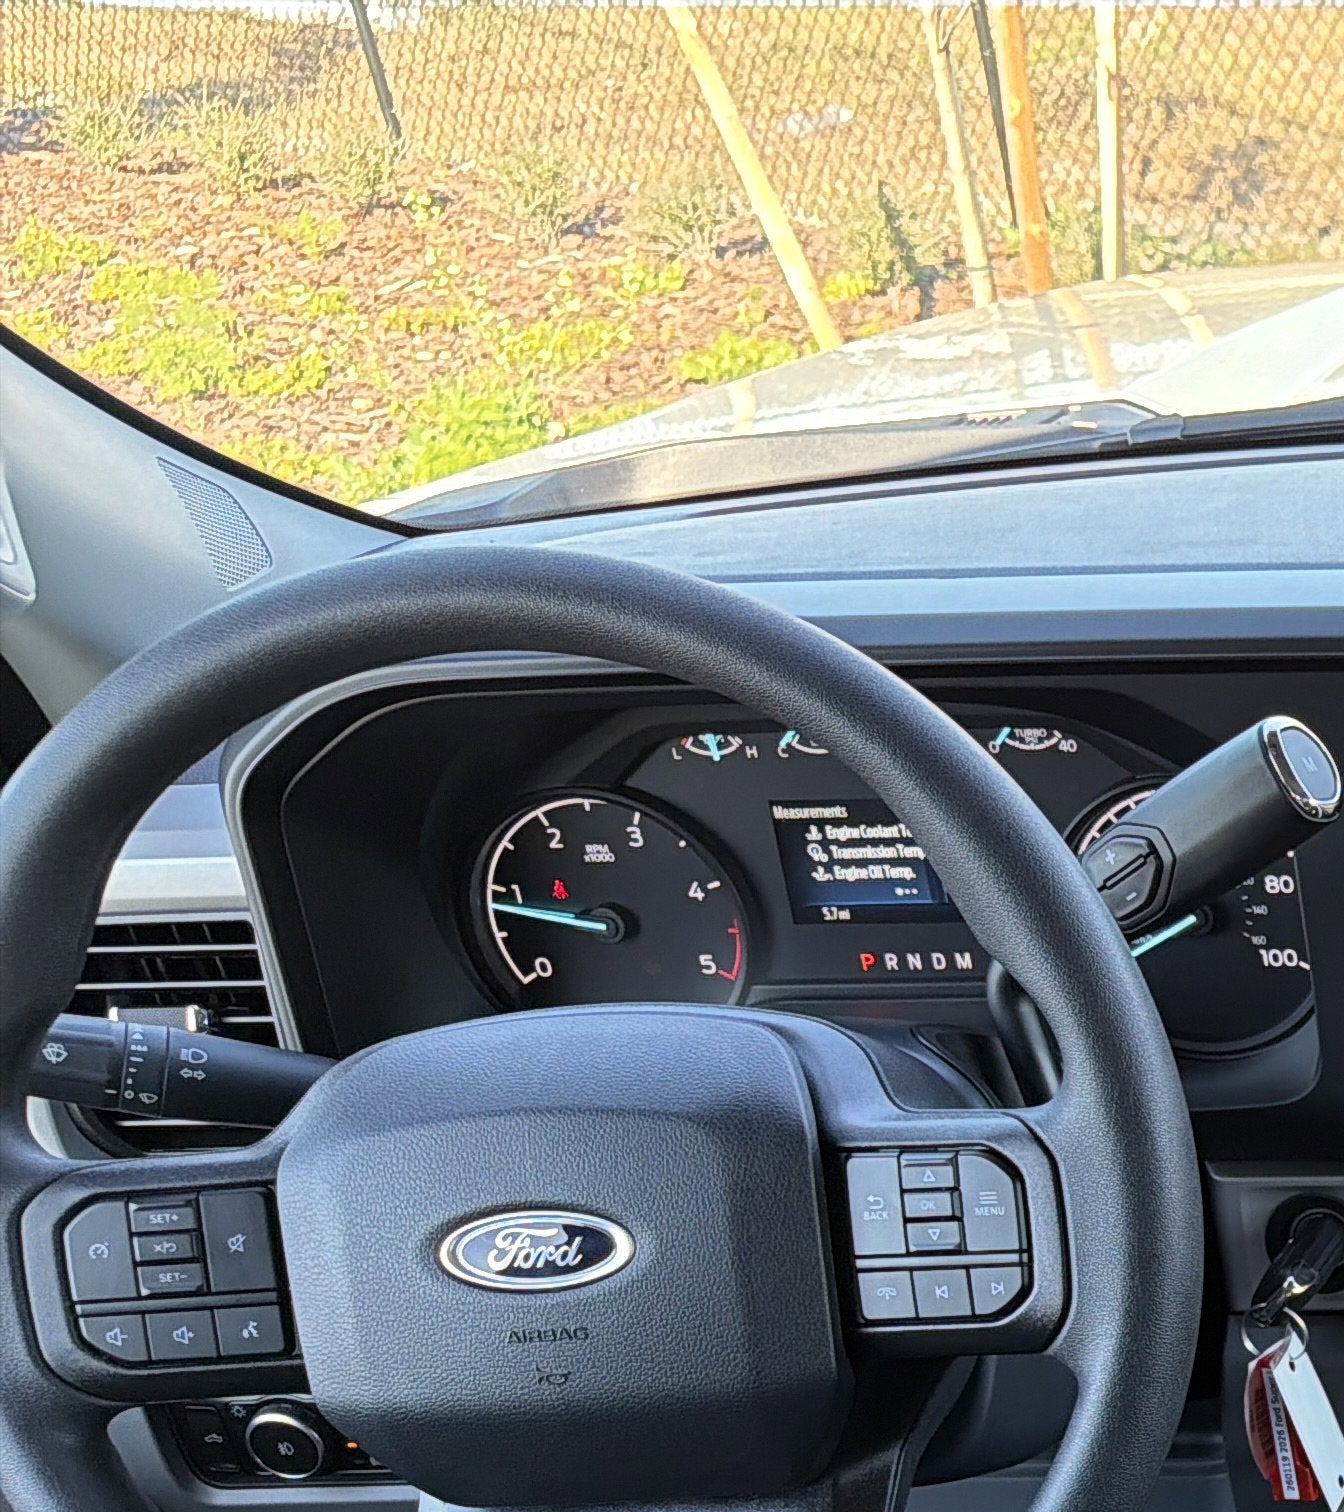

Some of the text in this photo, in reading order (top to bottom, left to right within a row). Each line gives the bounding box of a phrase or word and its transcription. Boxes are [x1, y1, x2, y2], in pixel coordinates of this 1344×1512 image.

[1013, 728, 1047, 738] TURBO
[672, 747, 682, 760] L
[745, 745, 758, 758] H
[988, 741, 999, 753] 0
[1059, 739, 1077, 752] 40
[772, 805, 849, 819] Measurements
[546, 828, 564, 848] 2
[626, 826, 643, 848] 3
[825, 825, 860, 841] Engine
[860, 824, 899, 838] Coolant
[585, 843, 610, 853] RPM
[829, 844, 897, 859] Transmission
[833, 864, 916, 881] Engine Oil Temp.
[688, 880, 705, 901] 4
[1264, 875, 1294, 893] 80
[511, 884, 522, 904] 1
[1252, 905, 1268, 915] 140
[1251, 936, 1267, 945] 160
[699, 954, 717, 975] 5
[860, 952, 973, 971] P R N D M
[1259, 949, 1298, 967] 100
[535, 957, 553, 977] 0
[920, 1200, 936, 1210] OK
[974, 1206, 1005, 1216] MENU
[863, 1211, 889, 1221] BACK
[487, 1226, 583, 1271] Ford
[506, 1327, 590, 1344] AIRBAG
